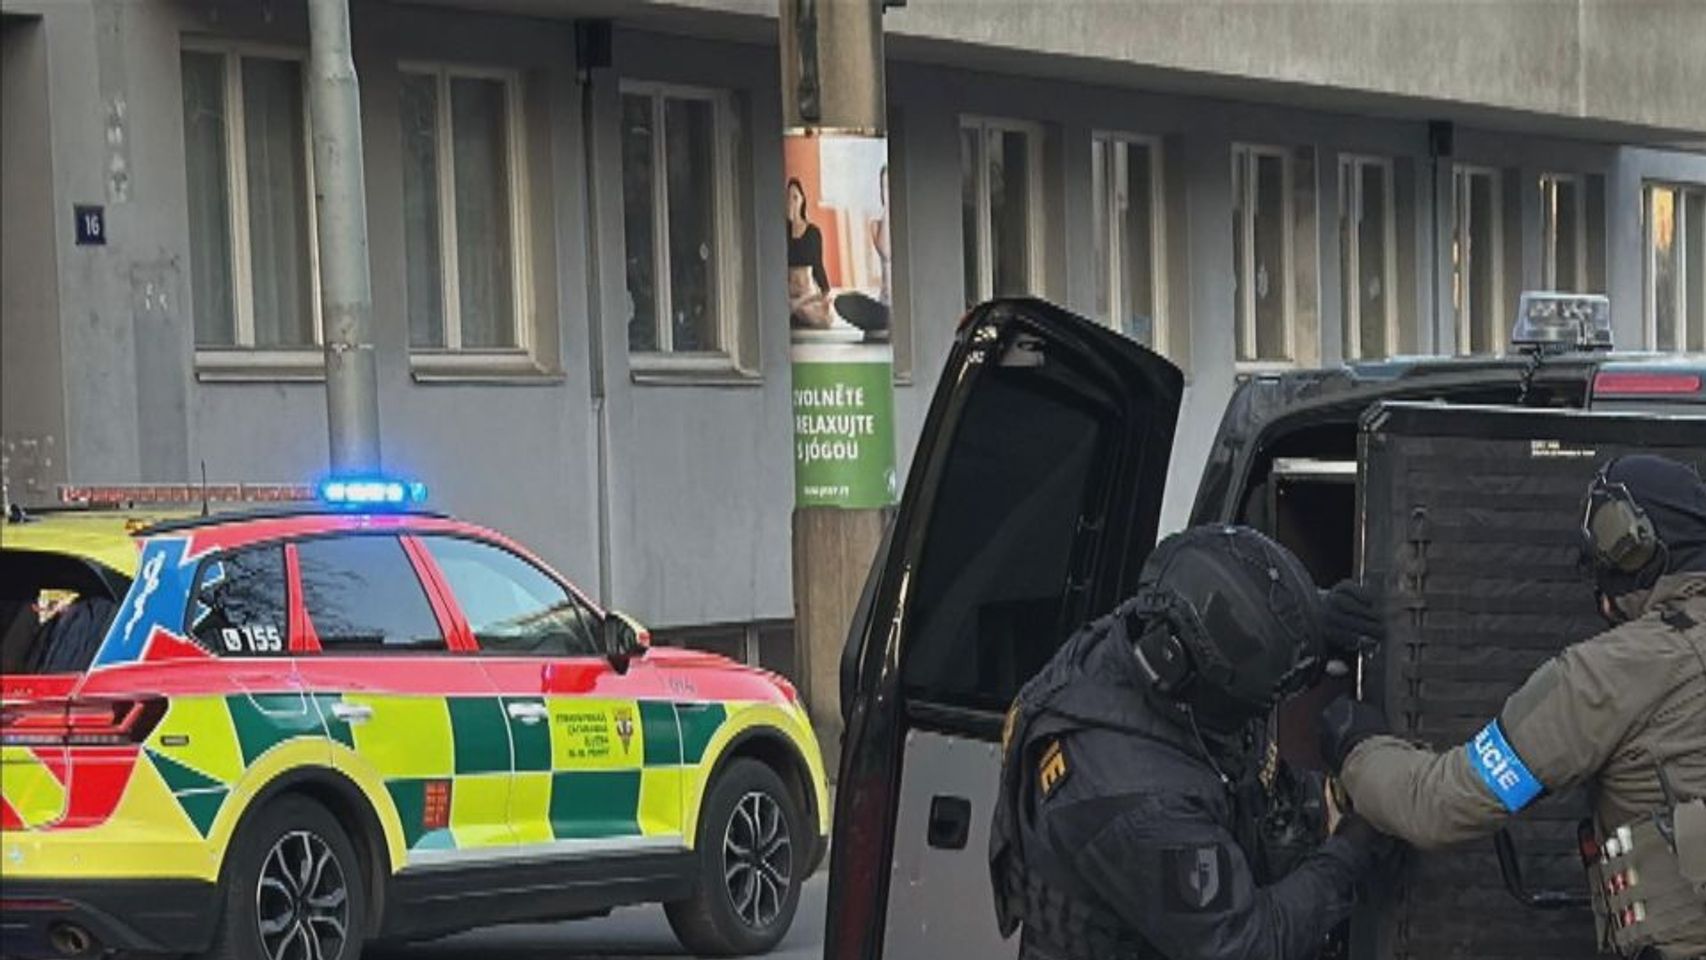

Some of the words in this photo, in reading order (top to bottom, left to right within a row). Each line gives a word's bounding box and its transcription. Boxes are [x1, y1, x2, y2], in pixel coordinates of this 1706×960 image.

[85, 214, 100, 236] 16
[241, 625, 282, 653] 155
[1474, 726, 1521, 791] LICIE
